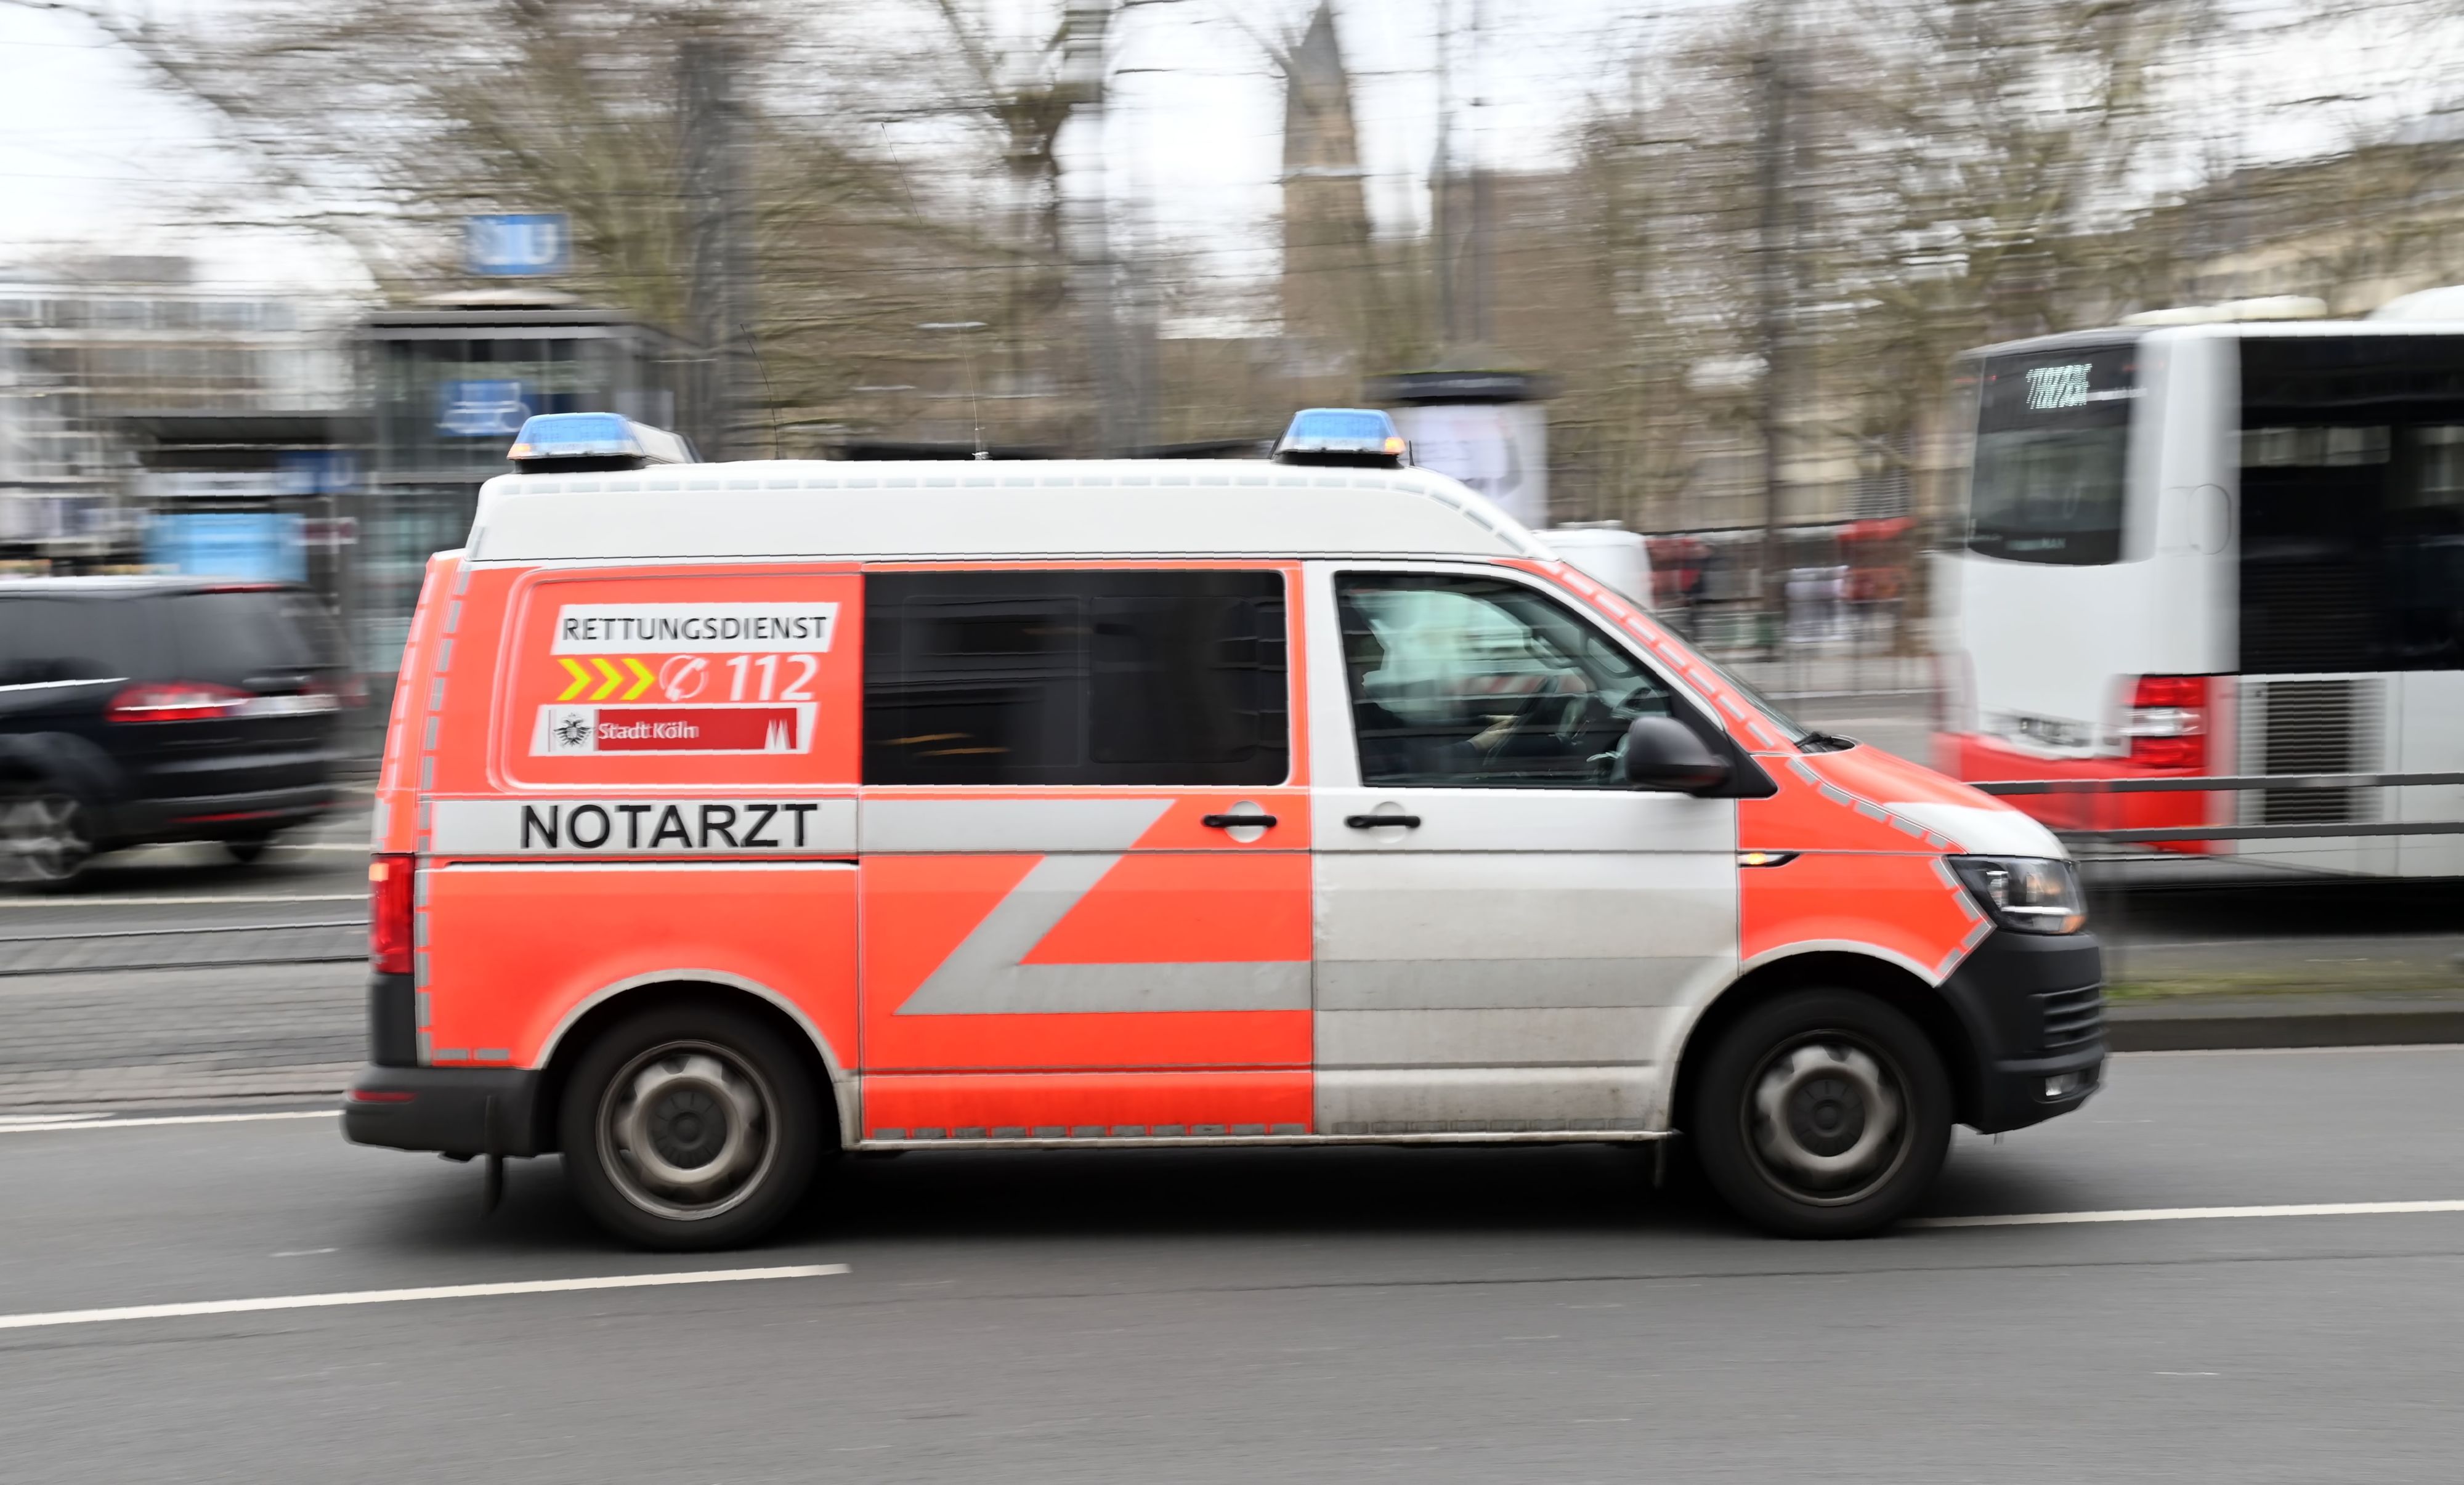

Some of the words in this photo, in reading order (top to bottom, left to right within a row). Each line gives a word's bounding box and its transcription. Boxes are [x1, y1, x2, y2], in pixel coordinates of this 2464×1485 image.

[562, 616, 829, 640] RETTUNGSDIENST
[726, 654, 820, 702] 112
[597, 722, 649, 740] Stadt
[652, 720, 700, 739] Köln
[520, 803, 820, 849] NOTARZT
